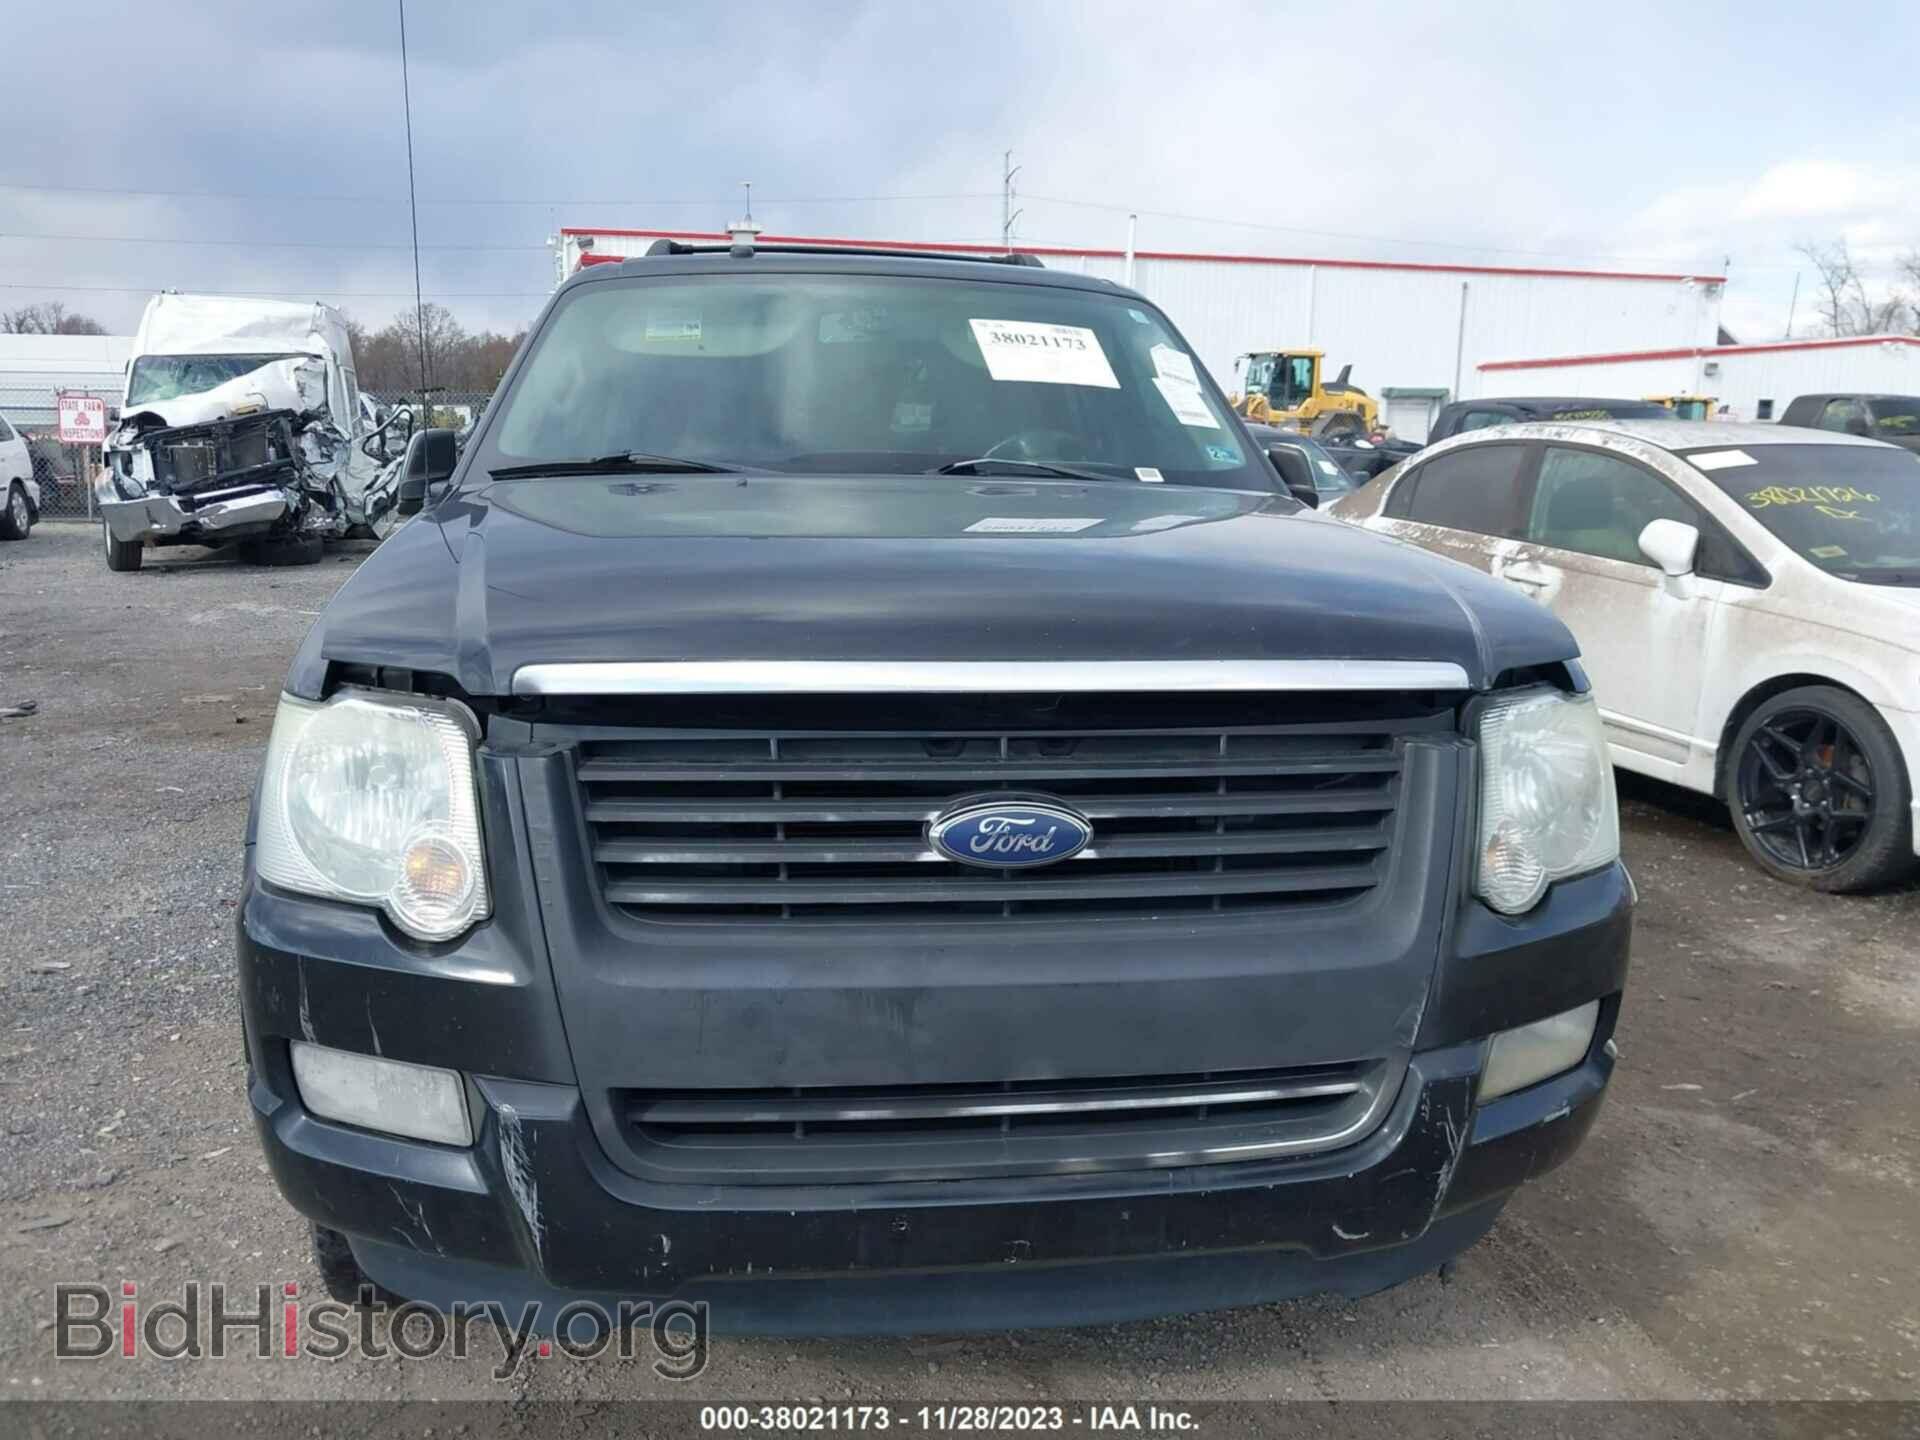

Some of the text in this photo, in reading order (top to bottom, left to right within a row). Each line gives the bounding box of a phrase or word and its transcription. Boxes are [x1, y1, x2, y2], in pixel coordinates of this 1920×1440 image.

[990, 331, 1087, 350] 38021173
[61, 400, 79, 410] STATE
[970, 817, 1057, 853] Ford
